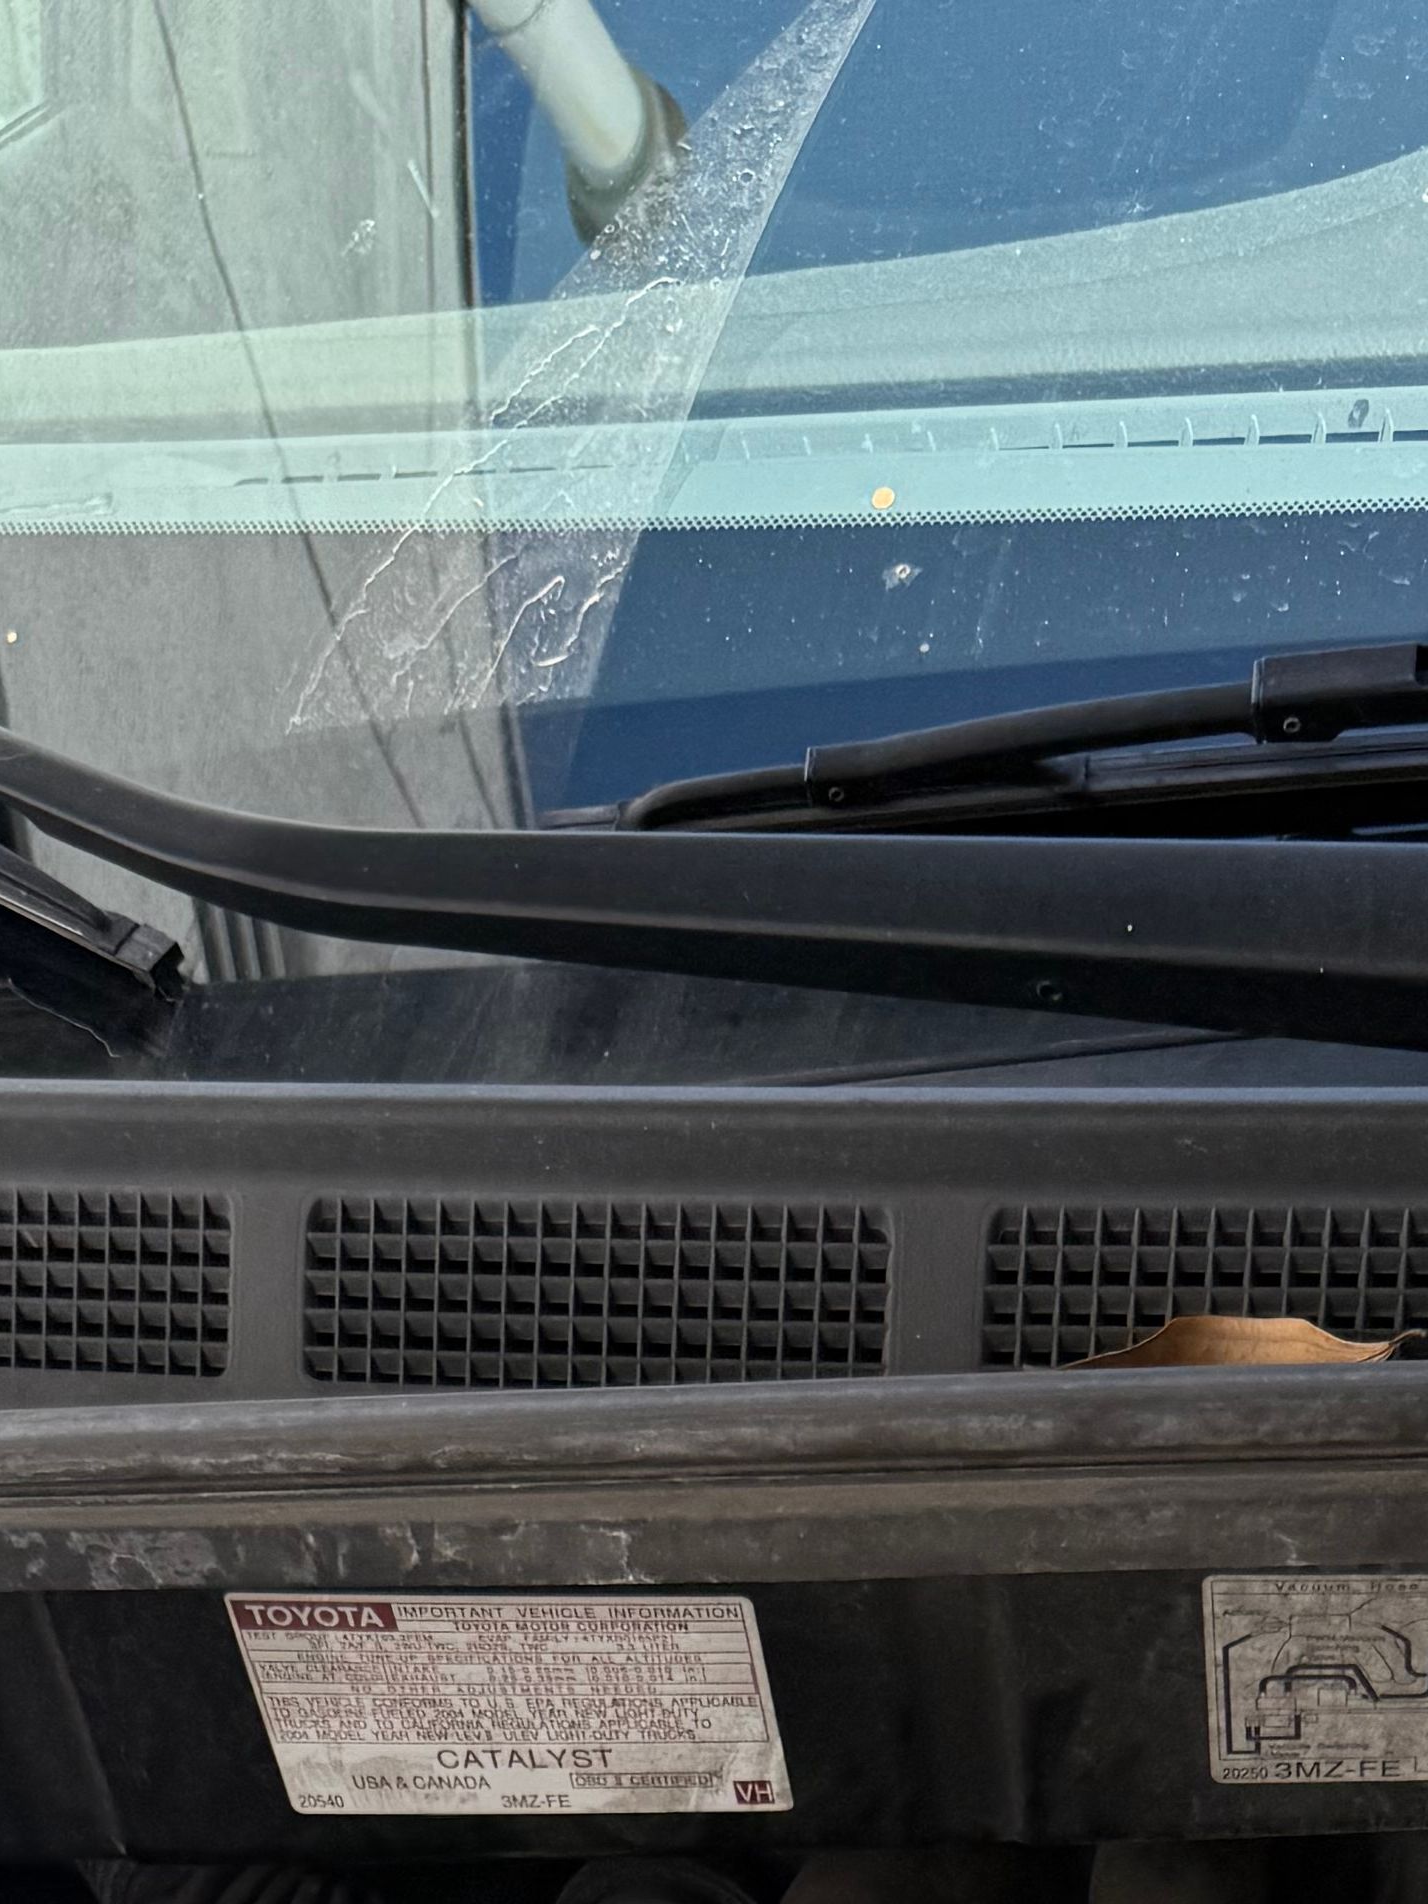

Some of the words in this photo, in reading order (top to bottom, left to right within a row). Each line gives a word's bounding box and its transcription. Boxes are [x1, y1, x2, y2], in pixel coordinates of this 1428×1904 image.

[1275, 1582, 1351, 1592] Vacuum
[1370, 1581, 1419, 1592] Hose
[244, 1603, 385, 1628] TOYOTA
[397, 1606, 504, 1619] IMPORTANT
[516, 1606, 596, 1619] VEHICLE
[608, 1606, 740, 1619] INFORMATION
[453, 1621, 510, 1632] TOYOTA
[515, 1621, 571, 1632] MOTOR
[576, 1621, 689, 1632] CORPORATION
[551, 1653, 581, 1662] FOR
[591, 1654, 616, 1663] ALL
[350, 1685, 372, 1694] NO
[386, 1686, 440, 1695] OTHER
[457, 1686, 575, 1695] ADJUSTMENTS
[266, 1697, 300, 1707] THIS
[306, 1697, 365, 1708] VEHICLE
[372, 1698, 453, 1708] CONFORMS
[459, 1698, 480, 1708] TO
[525, 1698, 556, 1708] EPA
[561, 1698, 664, 1709] REGULATIONS
[670, 1697, 759, 1708] APPLICABLE
[274, 1708, 291, 1718] TO
[433, 1709, 465, 1718] 2004
[471, 1709, 521, 1719] MODEL
[530, 1709, 568, 1719] YEAR
[573, 1709, 606, 1719] NEW
[614, 1708, 699, 1719] LIGHT-DUTY
[275, 1719, 332, 1730] TRUCKS
[339, 1720, 368, 1730] AND
[376, 1720, 394, 1730] TO
[401, 1719, 484, 1730] CALIFORNIA
[490, 1719, 591, 1730] REGULATIONS
[598, 1719, 685, 1730] APPLICABLE
[691, 1718, 713, 1729] TO
[280, 1731, 310, 1741] 2004
[315, 1731, 365, 1741] MODEL
[371, 1731, 409, 1741] YEAR
[416, 1731, 448, 1741] NEW
[502, 1731, 539, 1741] ULEV
[546, 1730, 630, 1741] LIGHT-DUTY
[636, 1729, 697, 1741] TRUCKS
[436, 1748, 613, 1770] CATALYST
[1222, 1767, 1269, 1780] 20250
[1274, 1760, 1402, 1779] 3MZ-FE
[352, 1775, 393, 1790] USA
[396, 1776, 408, 1789] &
[412, 1774, 493, 1790] CANADA
[574, 1776, 607, 1787] OBD
[629, 1775, 709, 1787] CERTIFIED
[738, 1784, 774, 1803] VH
[299, 1794, 345, 1808] 20540
[500, 1794, 572, 1809] 3MZ-FE
